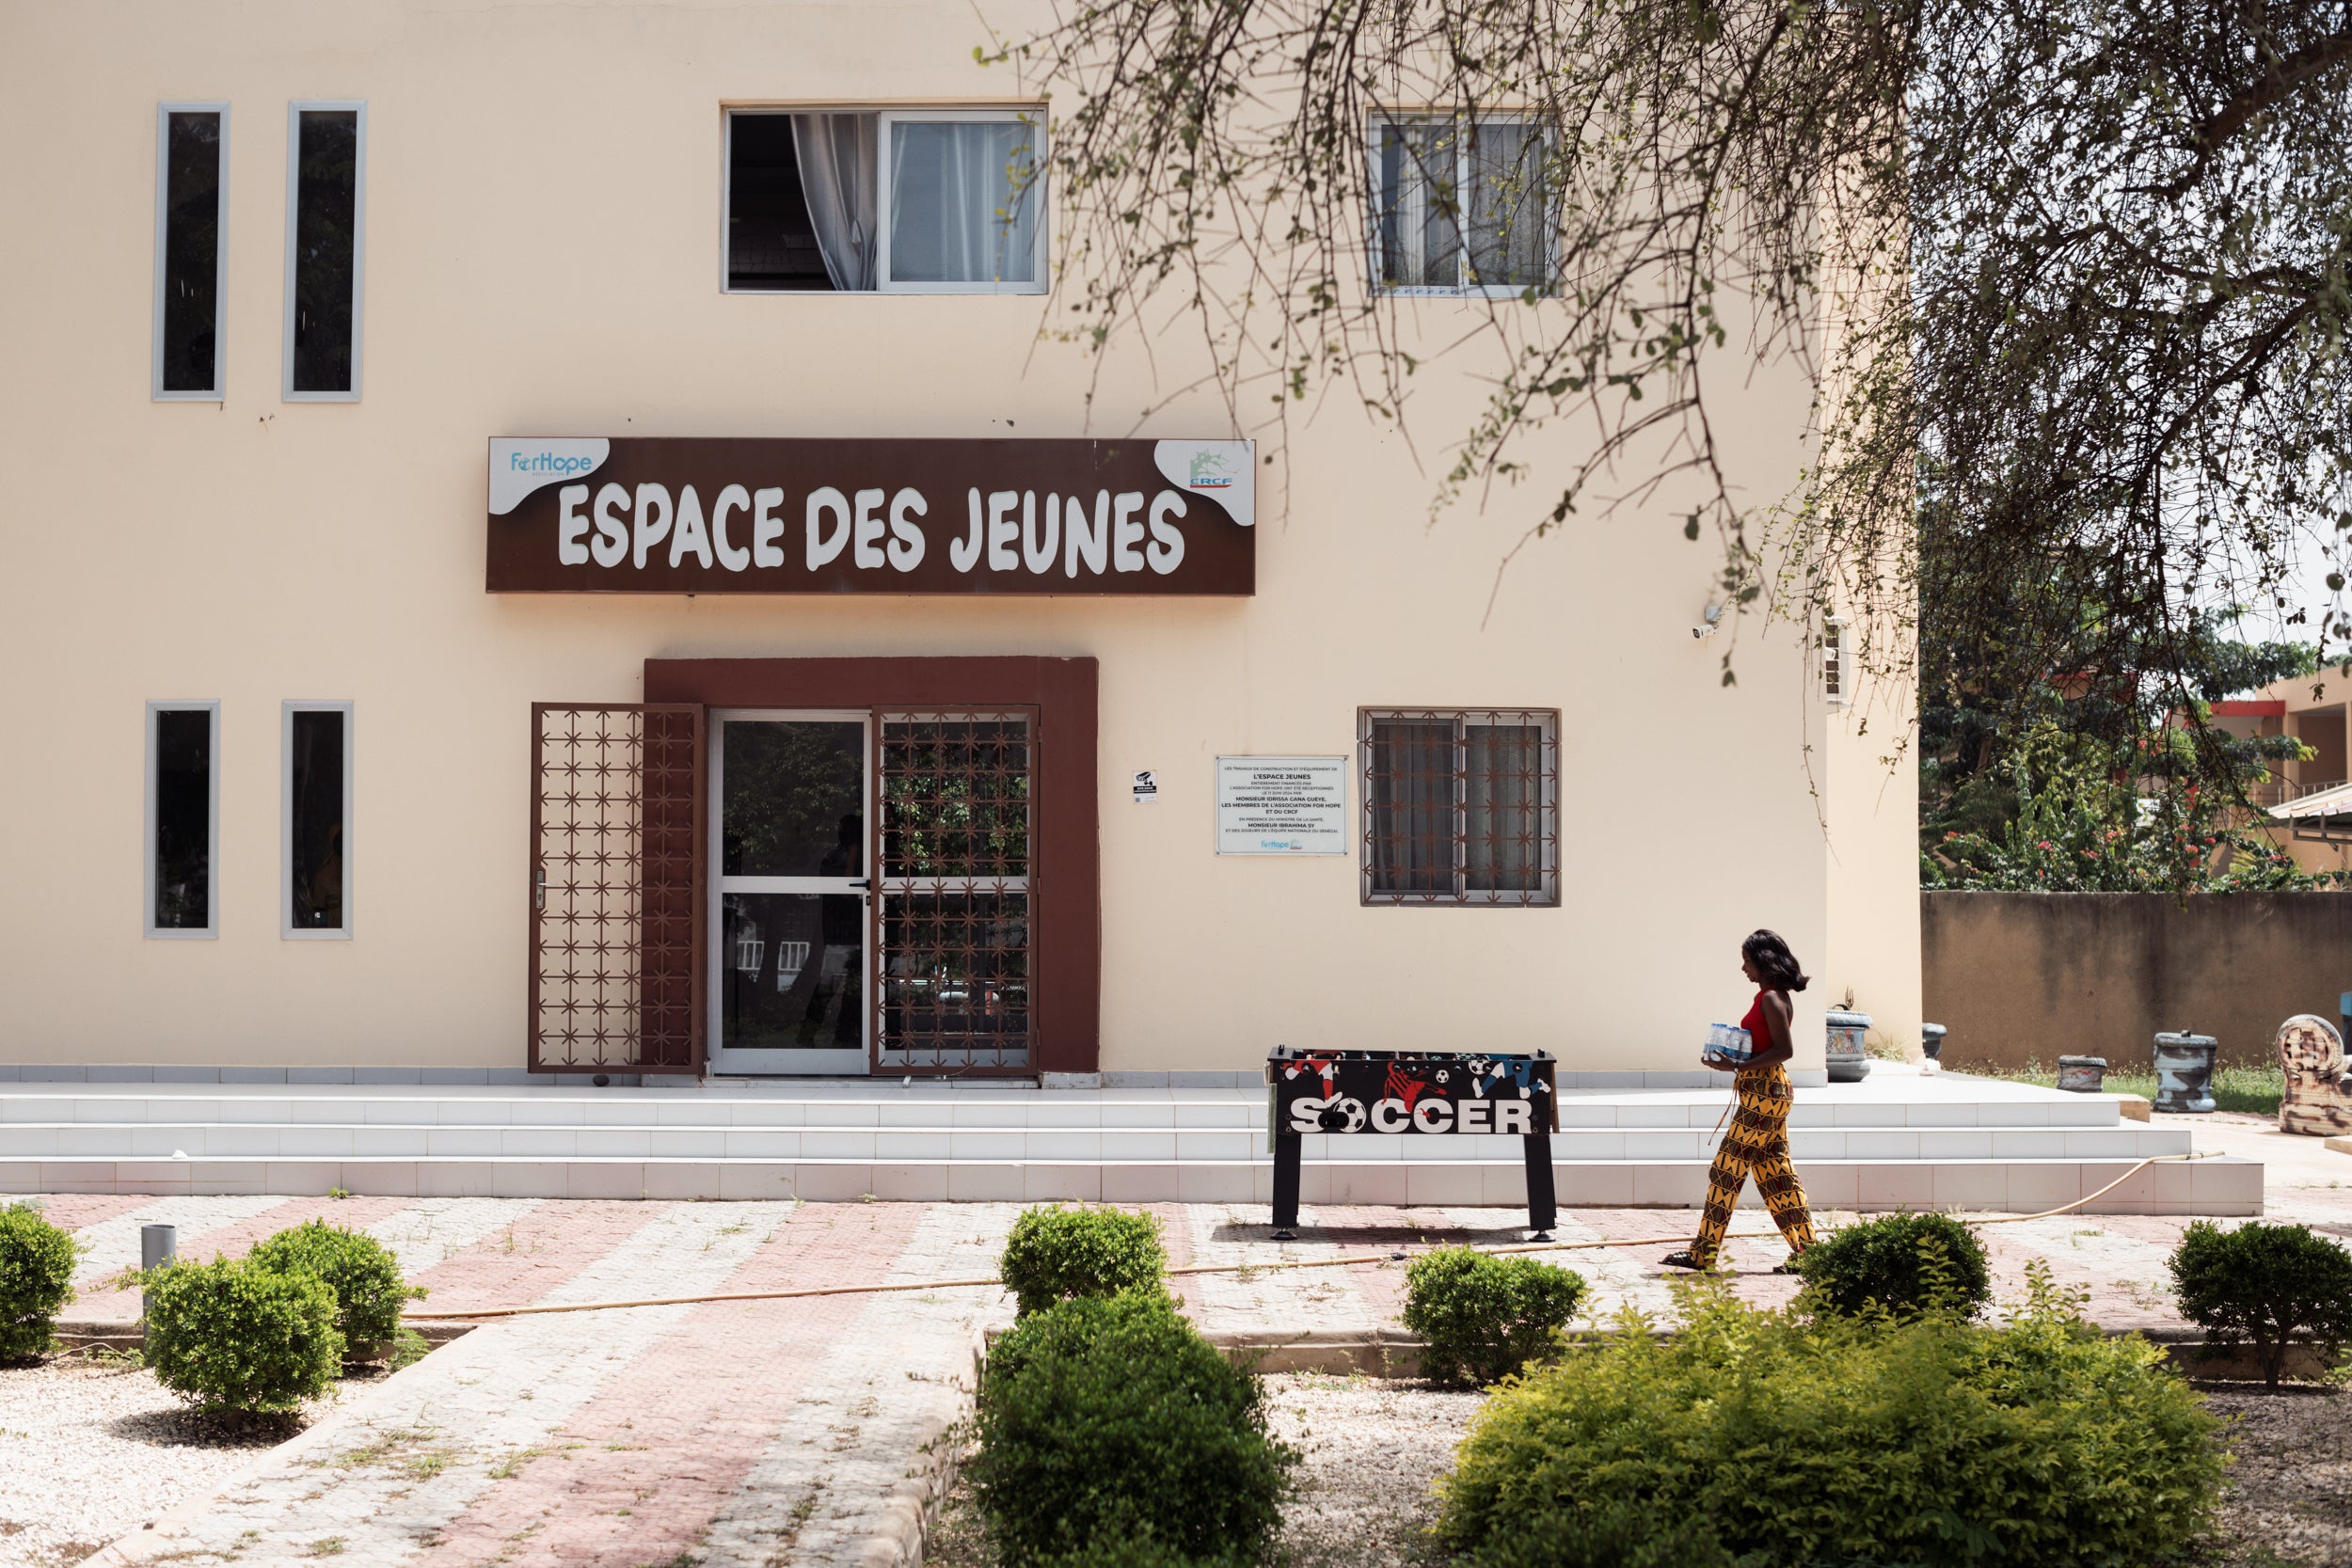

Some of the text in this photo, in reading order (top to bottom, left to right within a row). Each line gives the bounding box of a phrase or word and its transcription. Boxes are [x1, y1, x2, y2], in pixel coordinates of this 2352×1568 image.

[511, 451, 593, 476] ForHope
[558, 483, 1188, 579] ESPACE DES JEUNES
[1290, 1097, 1532, 1133] SOCCER
